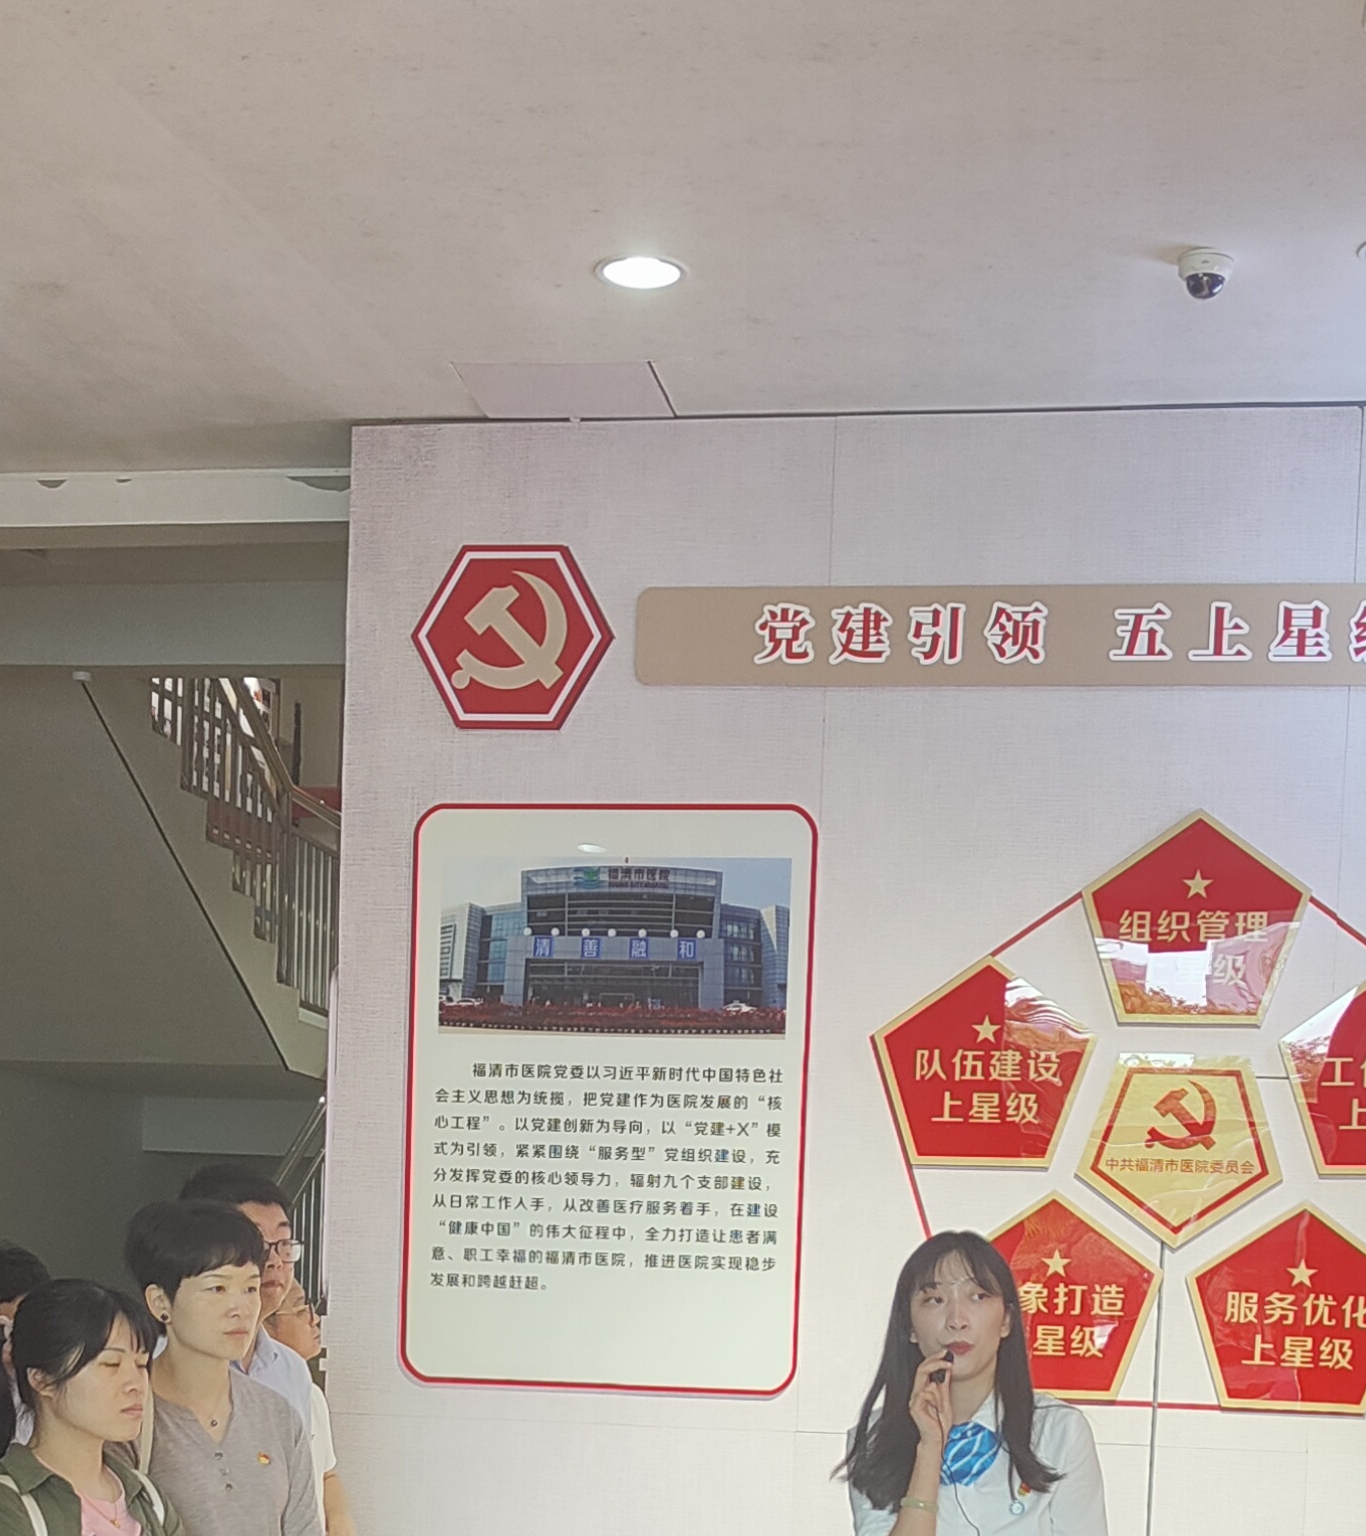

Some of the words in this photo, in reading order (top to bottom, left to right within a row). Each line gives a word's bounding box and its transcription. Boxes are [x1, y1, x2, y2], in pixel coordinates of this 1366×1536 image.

[756, 602, 1046, 664] 党建引领
[1119, 909, 1269, 943] 组织管理
[472, 1062, 784, 1085] 福清市医院党委以习近平新时代中国特色社
[915, 1049, 1062, 1086] 队伍建设
[931, 1091, 1040, 1124] 上星级
[1105, 1157, 1255, 1174] 中共福清市医院委员会
[1018, 1282, 1125, 1317] 象打造
[1033, 1325, 1104, 1359] 星级
[1241, 1333, 1353, 1371] 上星级
